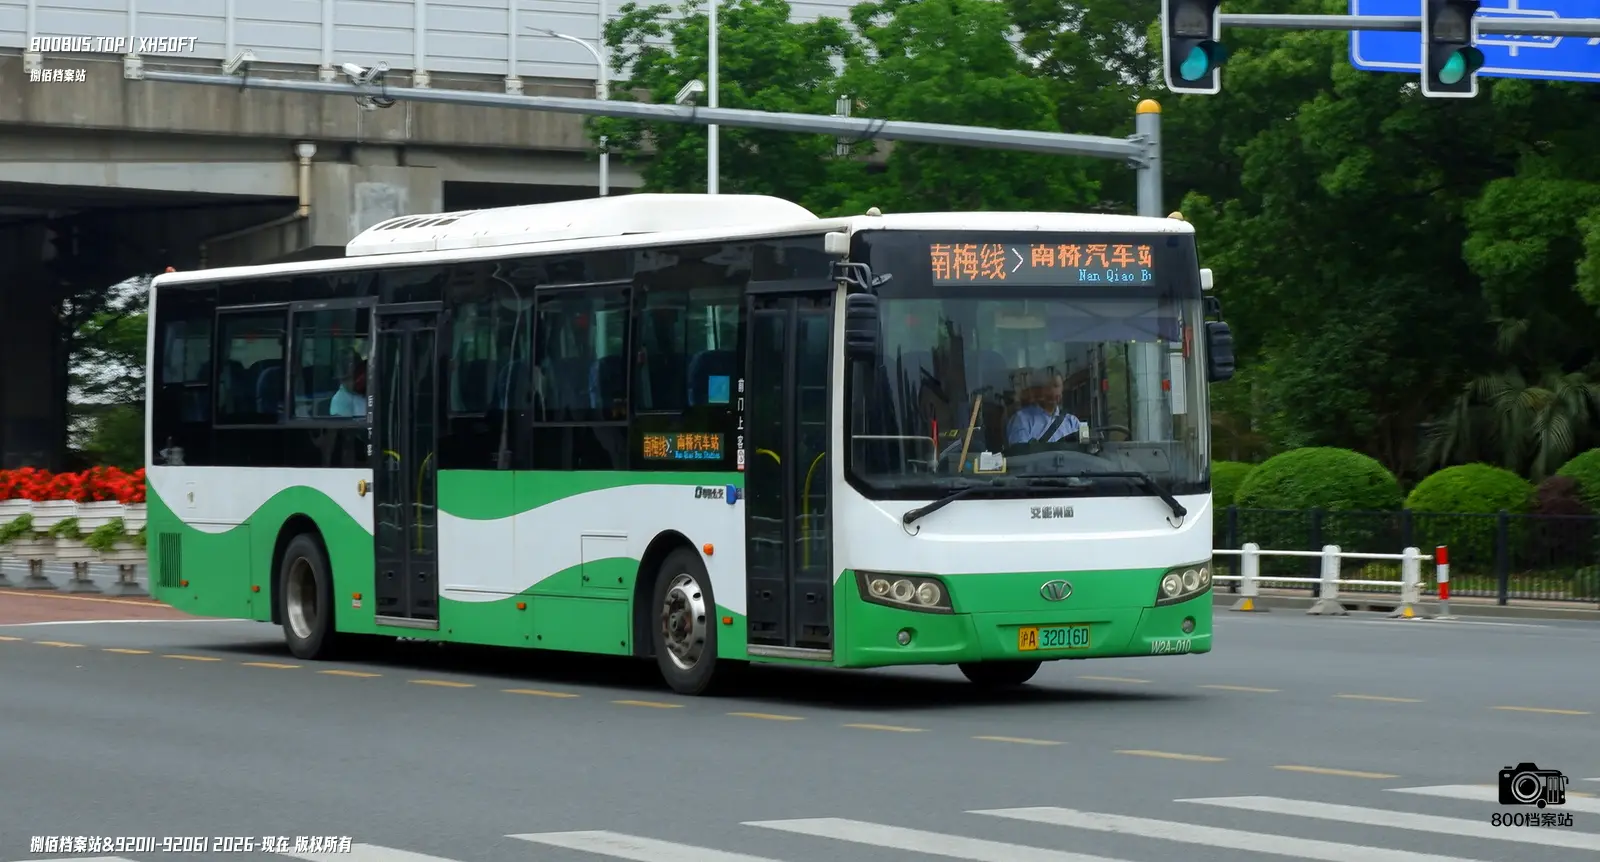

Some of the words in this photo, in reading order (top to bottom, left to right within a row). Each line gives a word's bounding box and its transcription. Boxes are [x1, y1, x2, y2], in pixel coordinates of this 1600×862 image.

[931, 244, 1006, 280] 南梅线
[1079, 269, 1100, 281] Nan
[1106, 268, 1134, 282] Qiao
[1151, 640, 1191, 654] W2A-010
